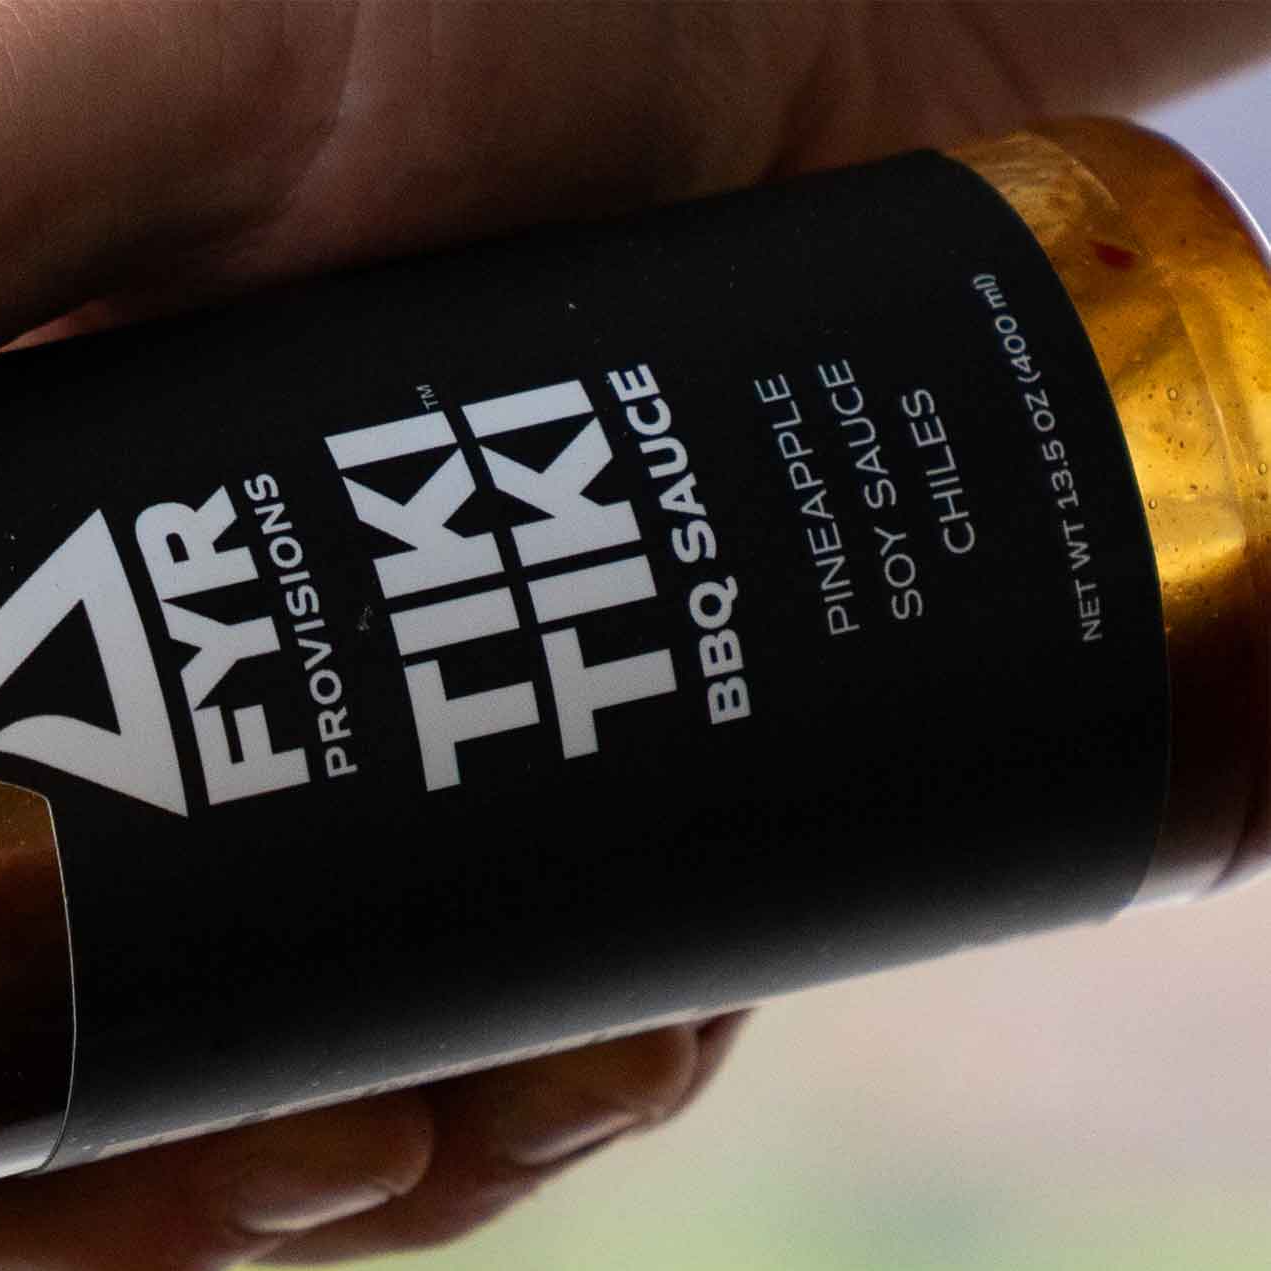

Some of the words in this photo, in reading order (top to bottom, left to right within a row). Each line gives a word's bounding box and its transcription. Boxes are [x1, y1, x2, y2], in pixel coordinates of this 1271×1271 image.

[995, 316, 1040, 382] (400
[1025, 390, 1054, 431] OZ
[607, 365, 716, 562] SAUCE
[755, 374, 858, 634] PINEAPPLE
[818, 360, 896, 508] SAUCE
[902, 390, 974, 553] CHILES
[1042, 440, 1078, 508] 13.5
[324, 411, 539, 791] TIKI
[461, 380, 676, 758] TIKI
[875, 528, 922, 619] SOY
[1063, 520, 1090, 569] WT
[1076, 580, 1100, 640] NET
[135, 486, 309, 805] FYR
[244, 474, 357, 777] PROVISIONS
[689, 576, 749, 724] BBQ
